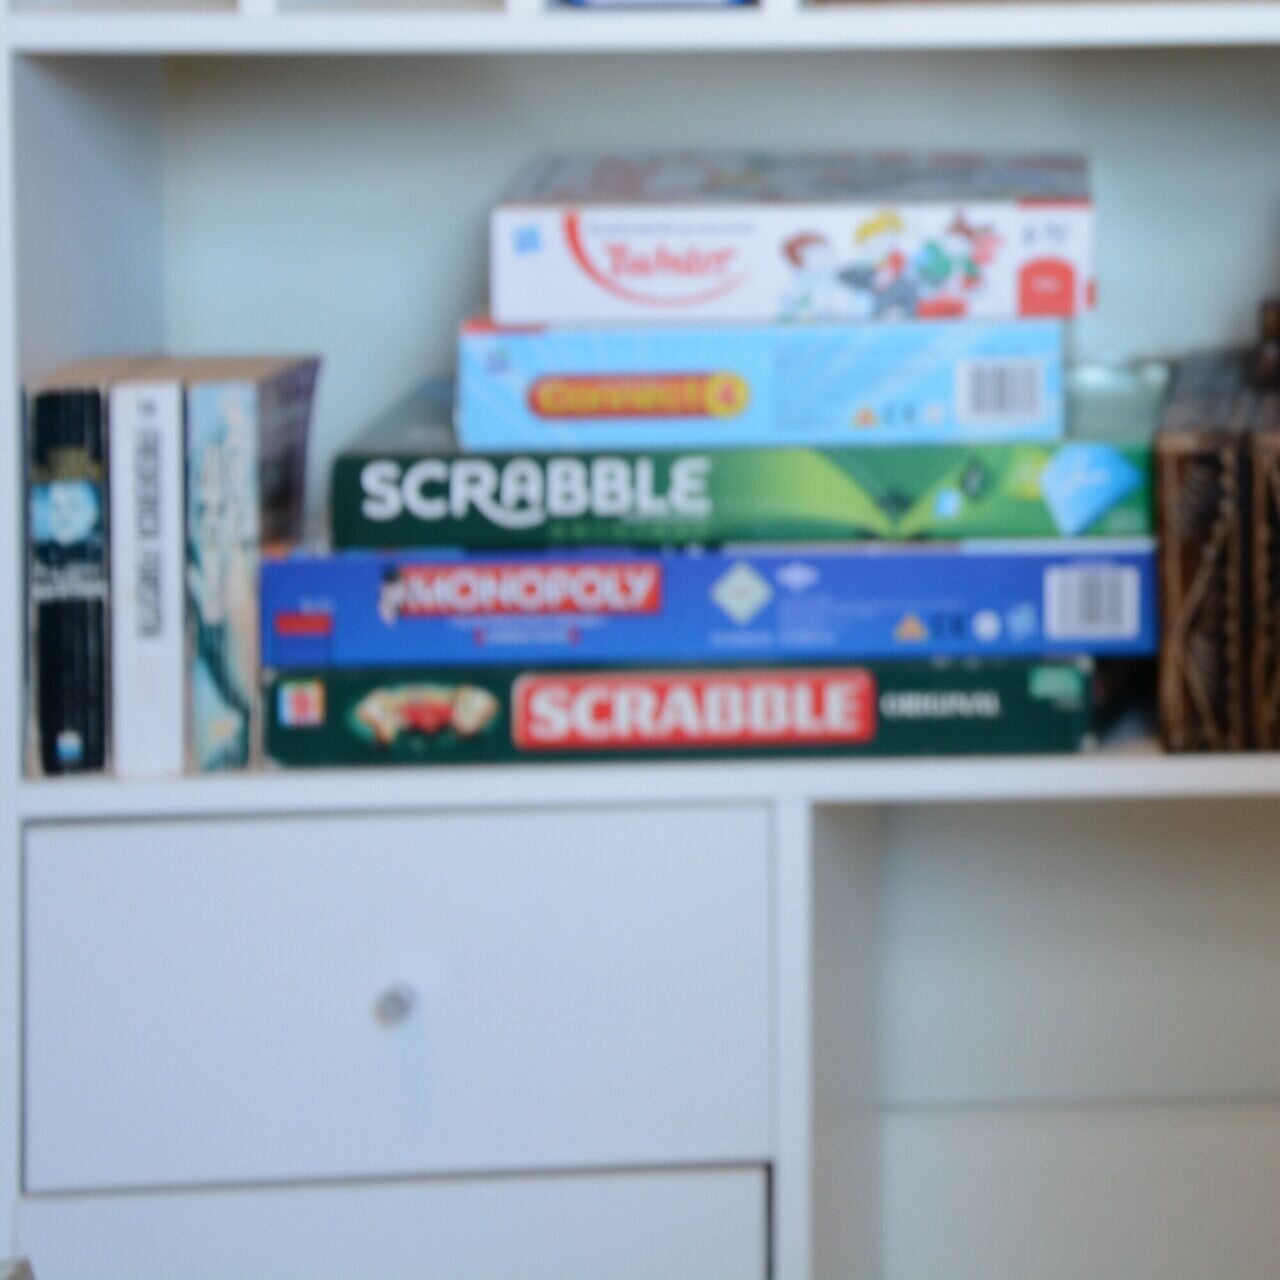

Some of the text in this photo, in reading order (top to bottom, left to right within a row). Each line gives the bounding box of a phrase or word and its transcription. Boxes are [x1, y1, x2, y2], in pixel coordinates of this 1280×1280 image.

[360, 458, 712, 529] SCRABBLE
[403, 566, 656, 613] MONOPOLY
[529, 678, 862, 741] SCRABBLE
